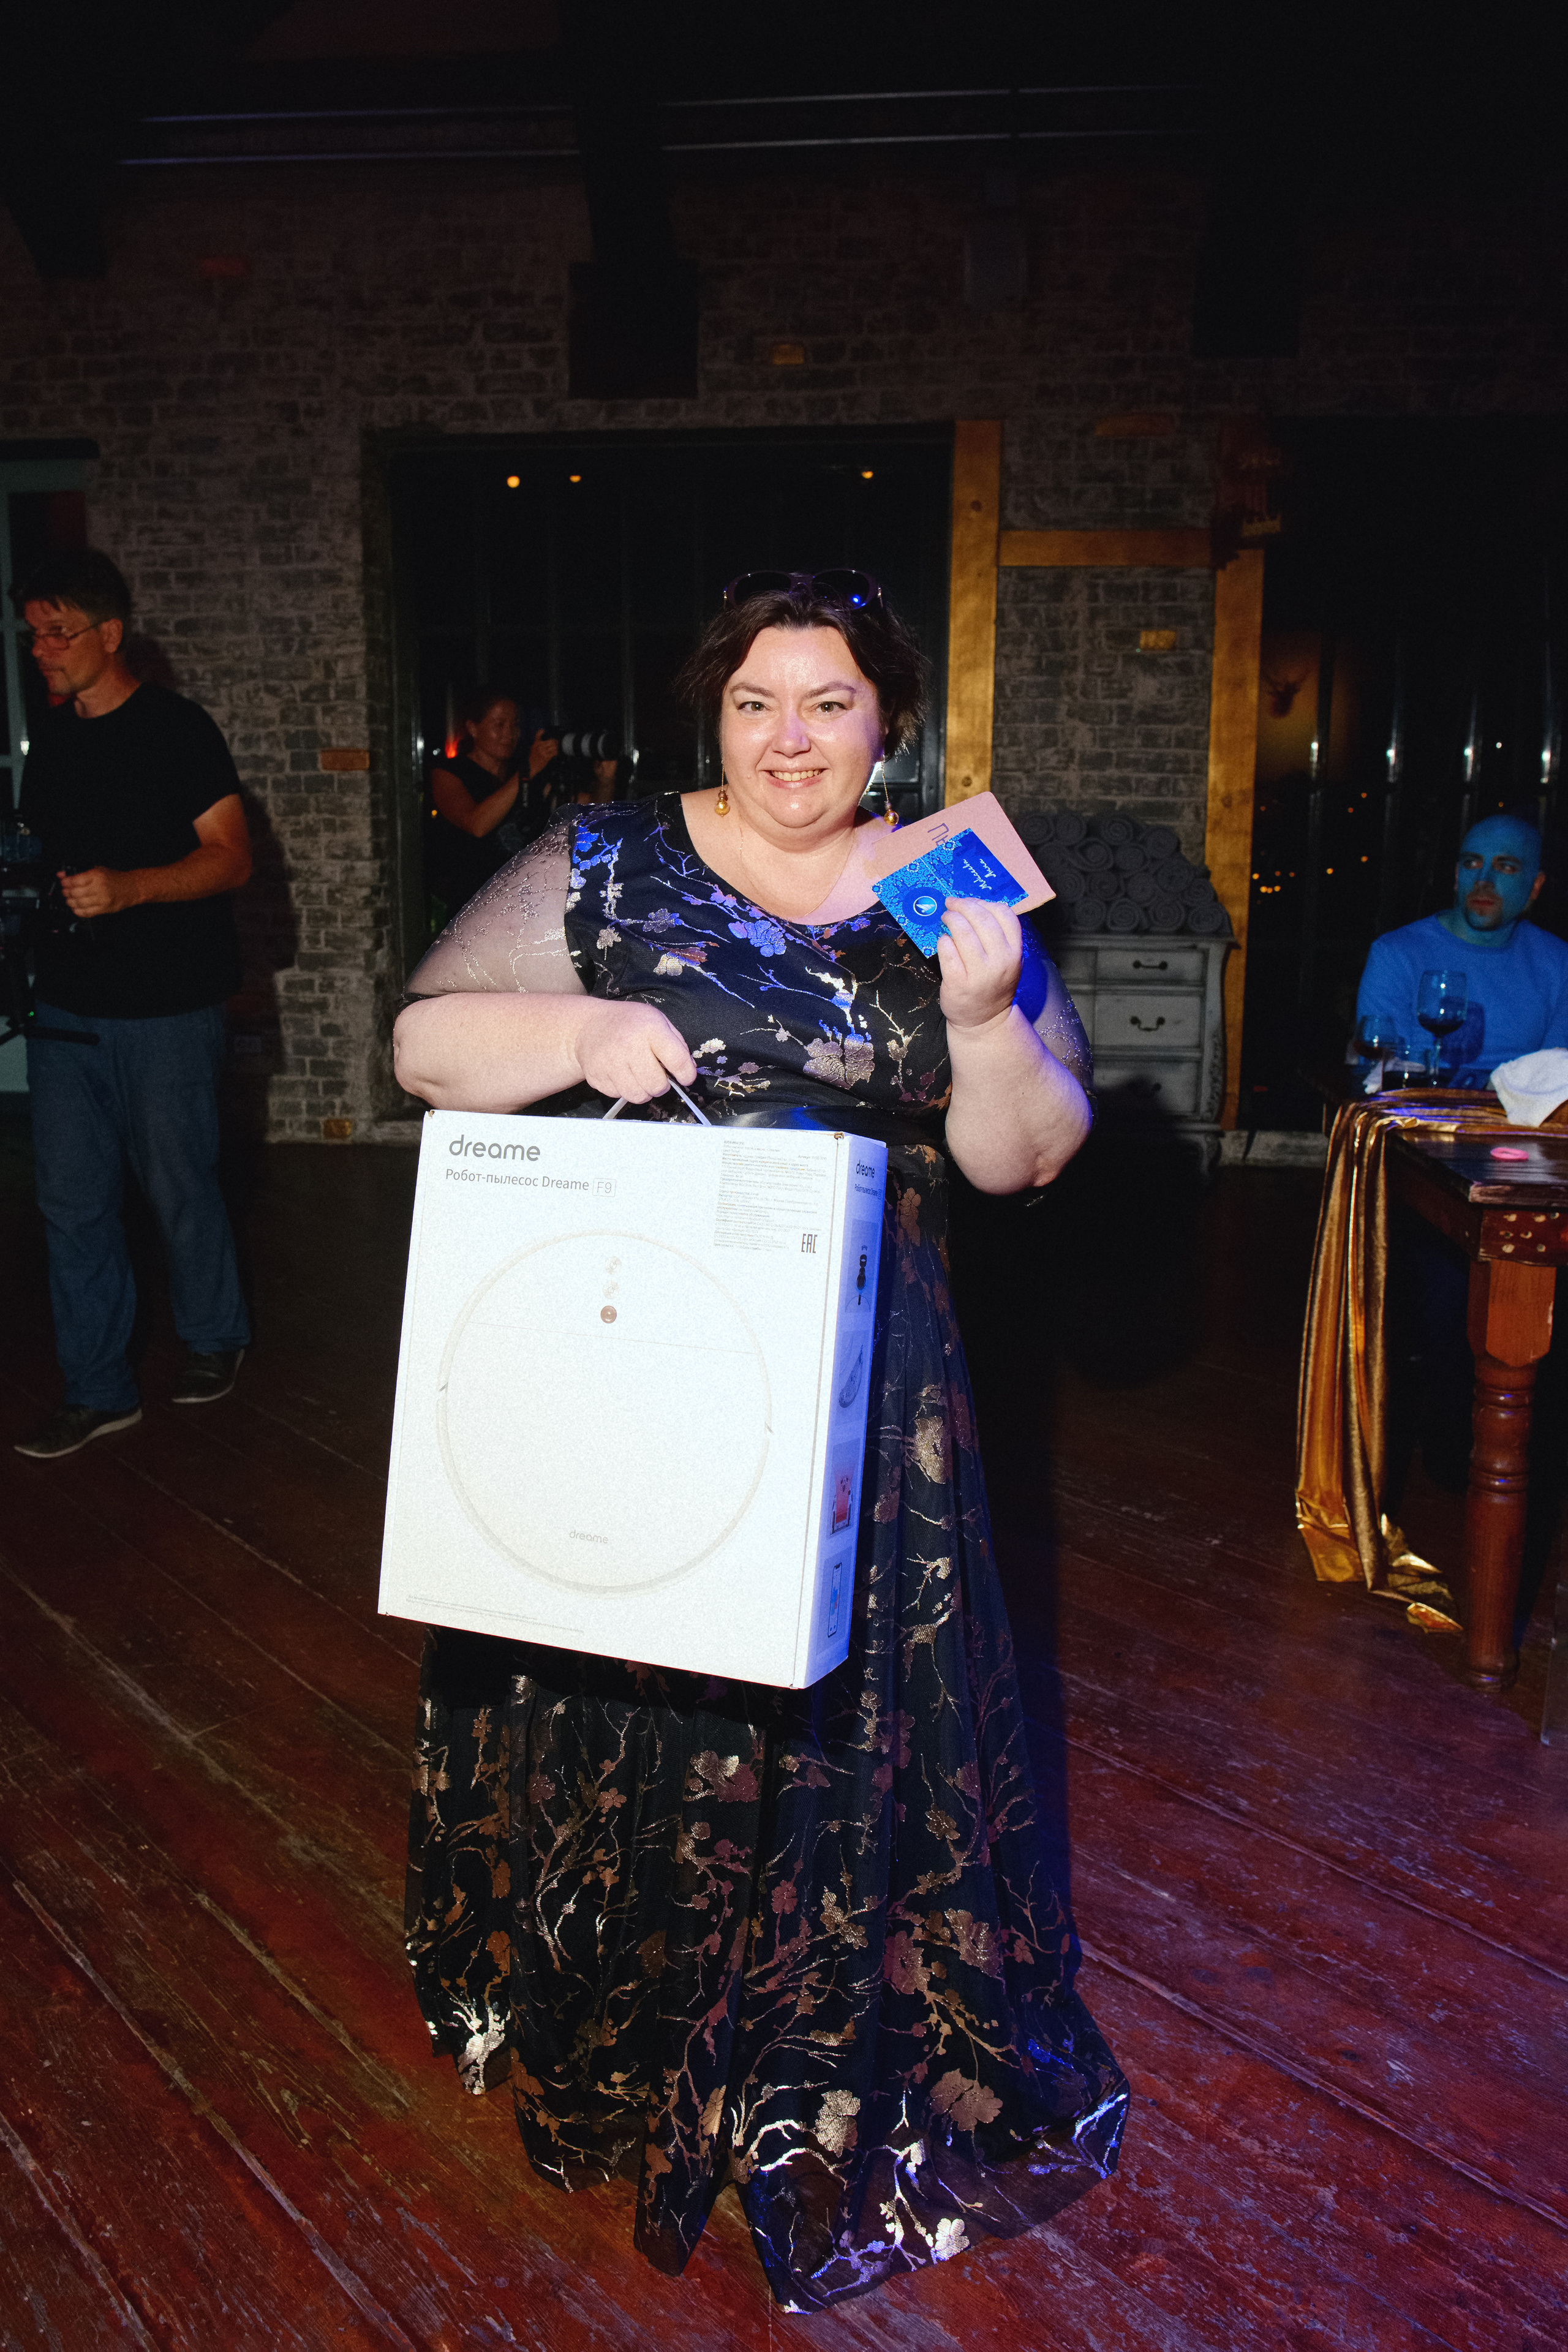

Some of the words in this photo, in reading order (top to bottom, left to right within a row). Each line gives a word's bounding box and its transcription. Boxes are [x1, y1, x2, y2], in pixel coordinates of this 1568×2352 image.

[979, 858, 997, 878] Анна
[449, 1134, 541, 1161] dreame
[856, 1159, 875, 1178] dreame
[445, 1169, 539, 1187] Робот-пылесос
[541, 1176, 590, 1191] Dreame
[596, 1182, 612, 1194] F9
[568, 1529, 609, 1544] dreame
